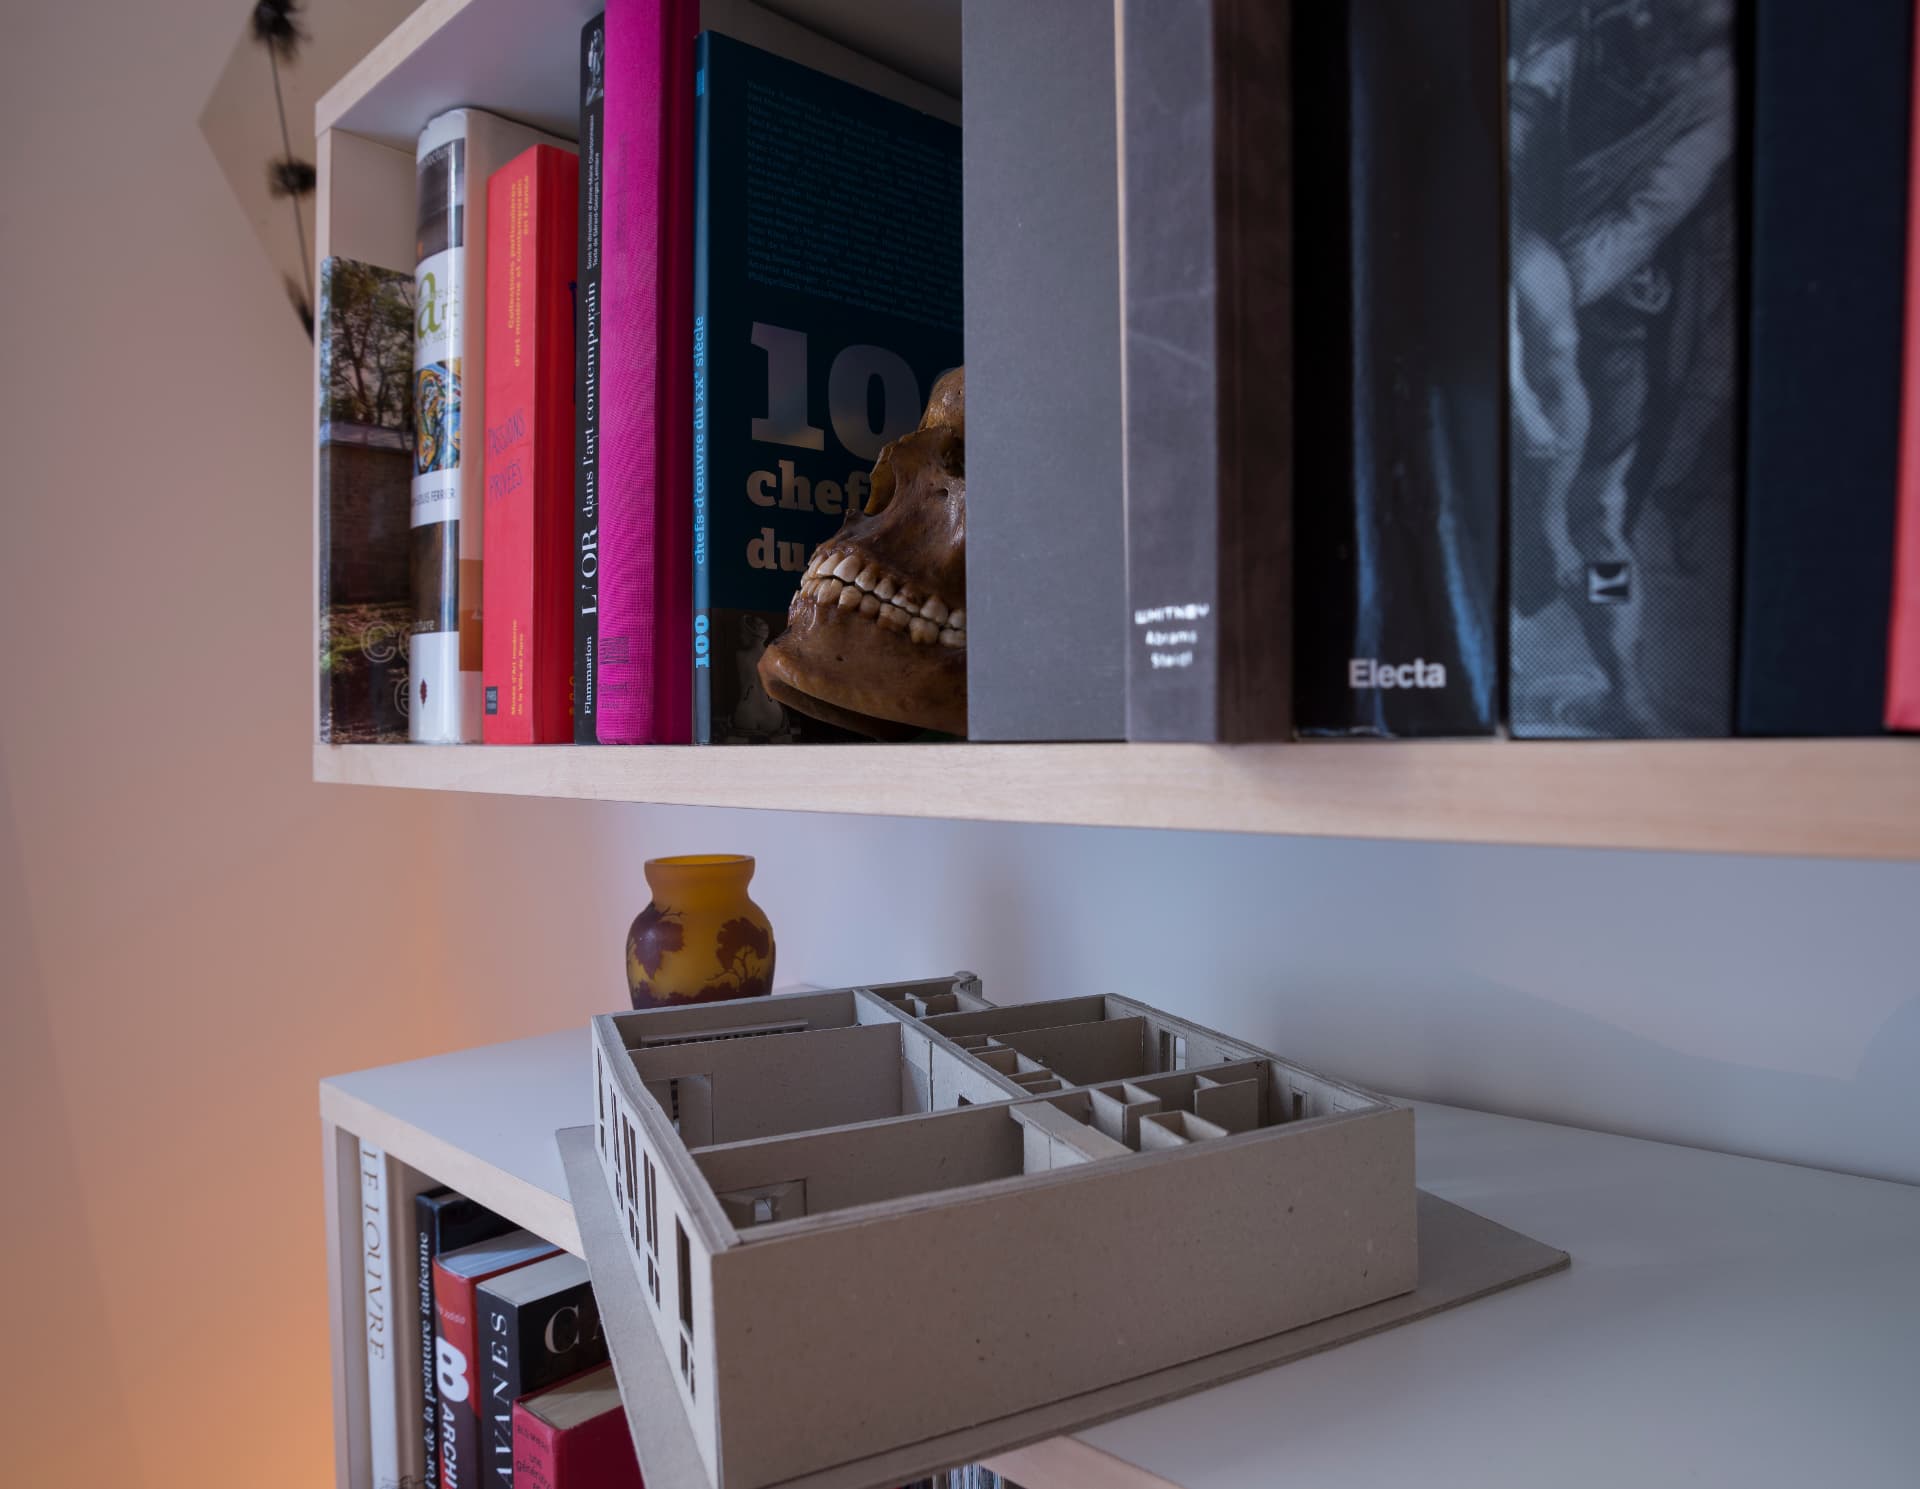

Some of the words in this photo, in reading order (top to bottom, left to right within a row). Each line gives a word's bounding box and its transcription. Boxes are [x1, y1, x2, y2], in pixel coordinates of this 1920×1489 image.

[585, 281, 599, 420] contemporain
[694, 315, 705, 366] siècle
[694, 405, 705, 429] du
[750, 321, 942, 462] 10
[583, 426, 596, 467] l'art
[583, 471, 595, 518] dans
[581, 525, 598, 616] L'OR
[746, 527, 809, 573] du
[694, 614, 710, 669] 100
[584, 635, 592, 716] Flammarion
[1349, 657, 1447, 688] Electa
[418, 1231, 431, 1316] italienne
[419, 1319, 437, 1403] peinture
[422, 1406, 434, 1424] la
[423, 1427, 436, 1452] de
